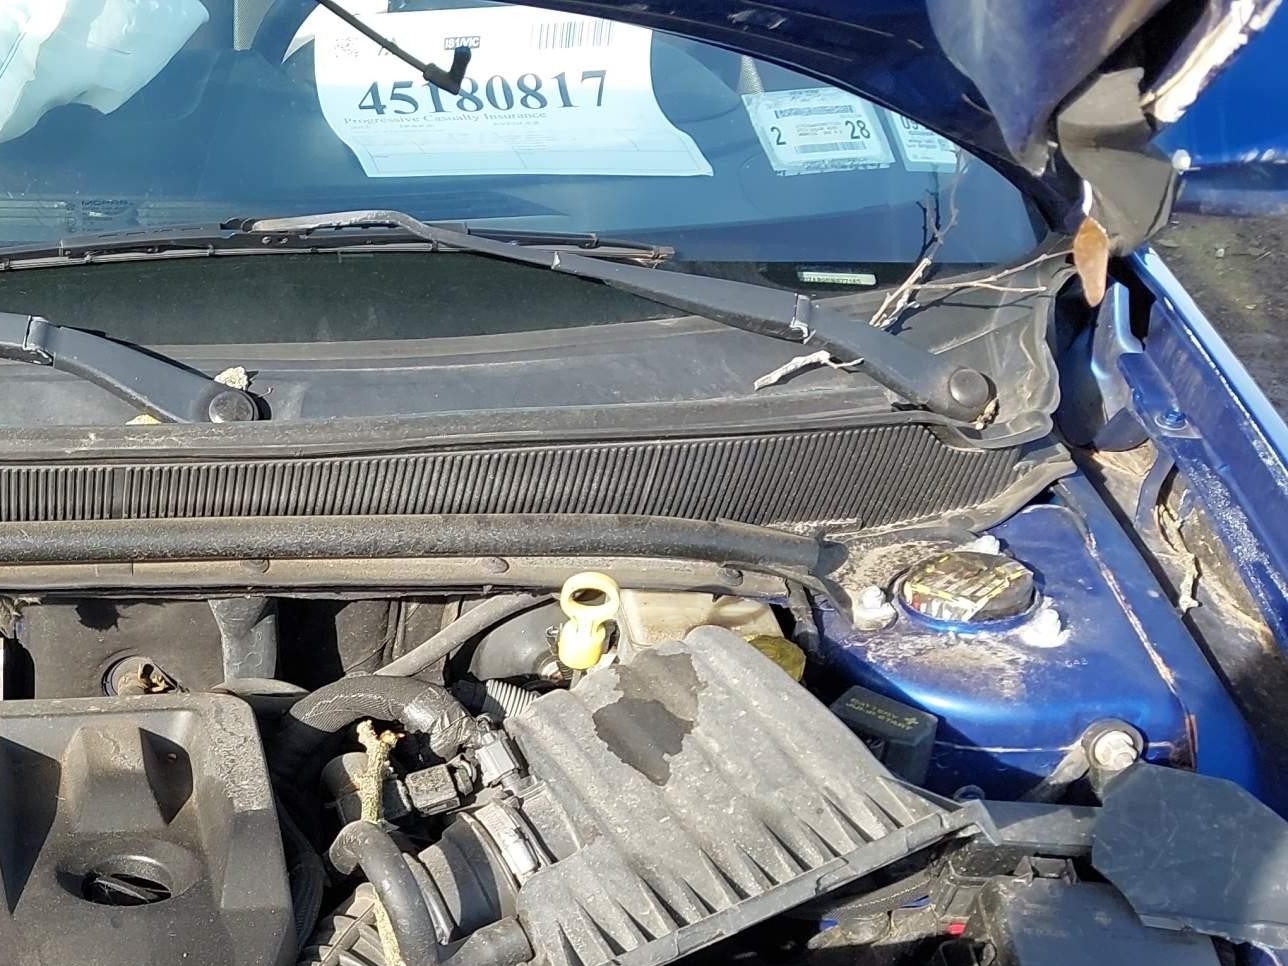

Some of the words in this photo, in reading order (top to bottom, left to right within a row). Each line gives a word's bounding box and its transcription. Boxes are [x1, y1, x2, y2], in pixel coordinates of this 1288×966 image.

[359, 70, 607, 115] 45180817
[344, 116, 420, 125] Progressive
[424, 113, 480, 123] Casualty
[484, 111, 547, 121] Insurance
[770, 126, 787, 146] 2
[845, 119, 871, 140] 28
